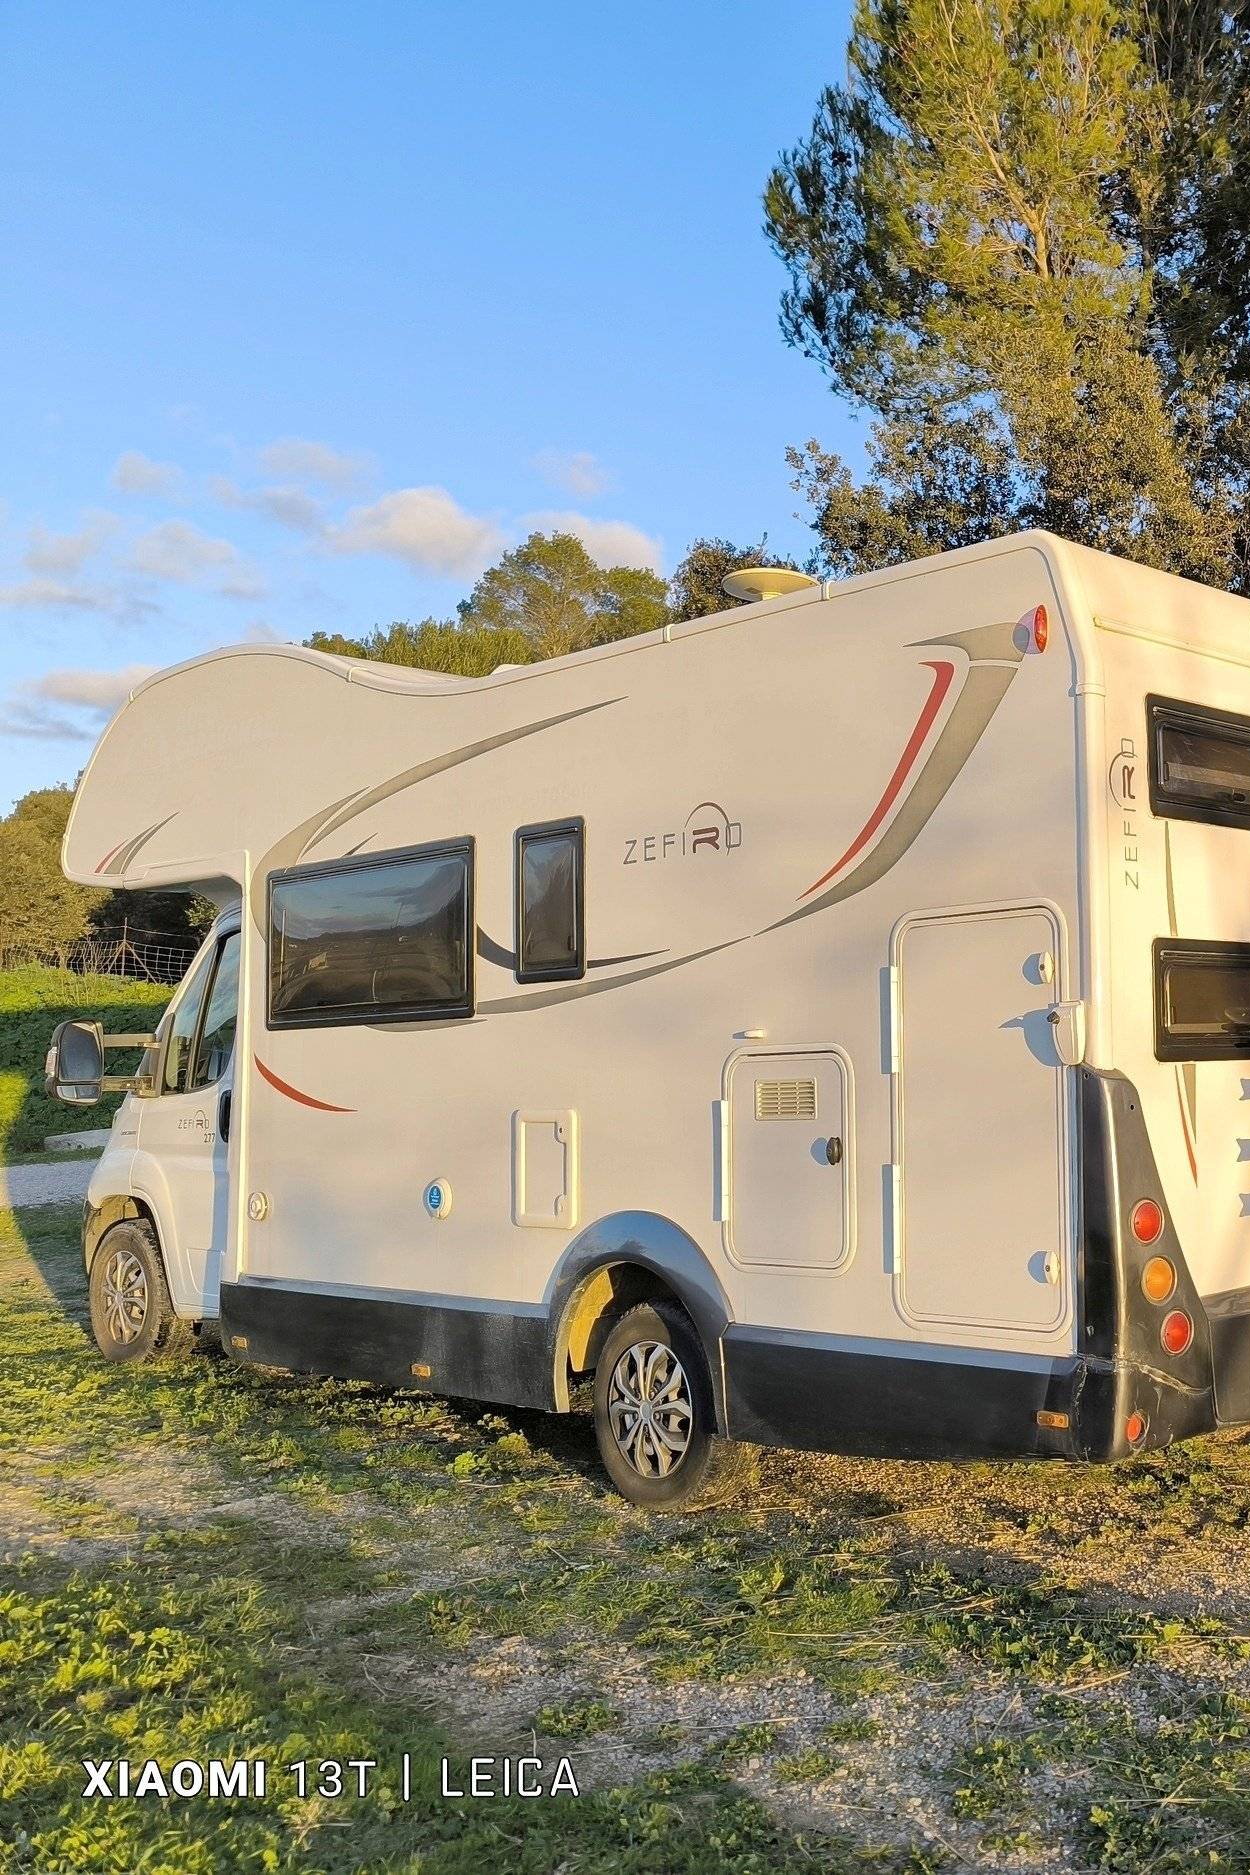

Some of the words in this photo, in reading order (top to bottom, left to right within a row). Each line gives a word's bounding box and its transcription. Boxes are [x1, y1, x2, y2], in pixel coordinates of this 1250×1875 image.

[1119, 737, 1140, 890] ZEFIRO
[623, 820, 742, 865] ZEFIRO
[203, 1132, 216, 1143] 277
